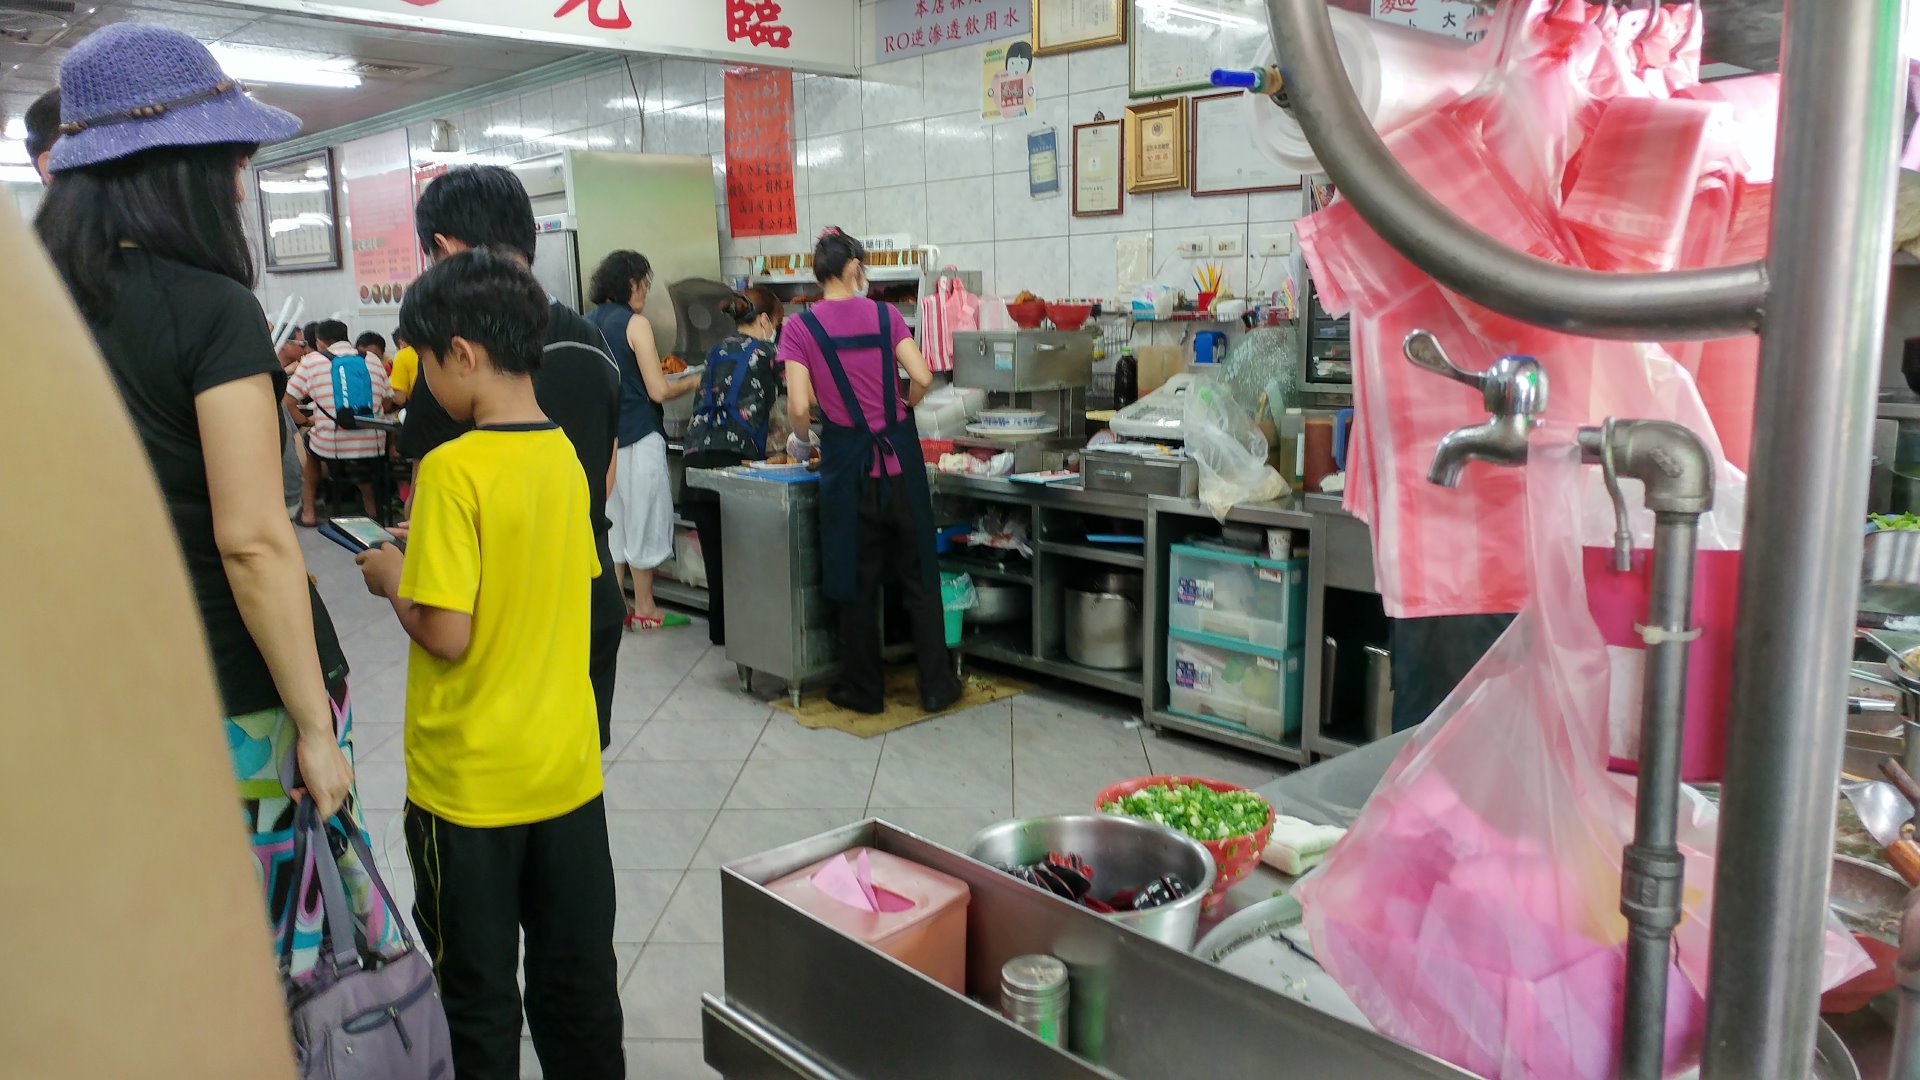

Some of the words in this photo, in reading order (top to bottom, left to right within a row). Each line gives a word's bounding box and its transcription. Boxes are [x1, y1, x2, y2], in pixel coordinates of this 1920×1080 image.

[884, 7, 1020, 53] RO逆滲透飲用水
[1442, 11, 1457, 29] 大
